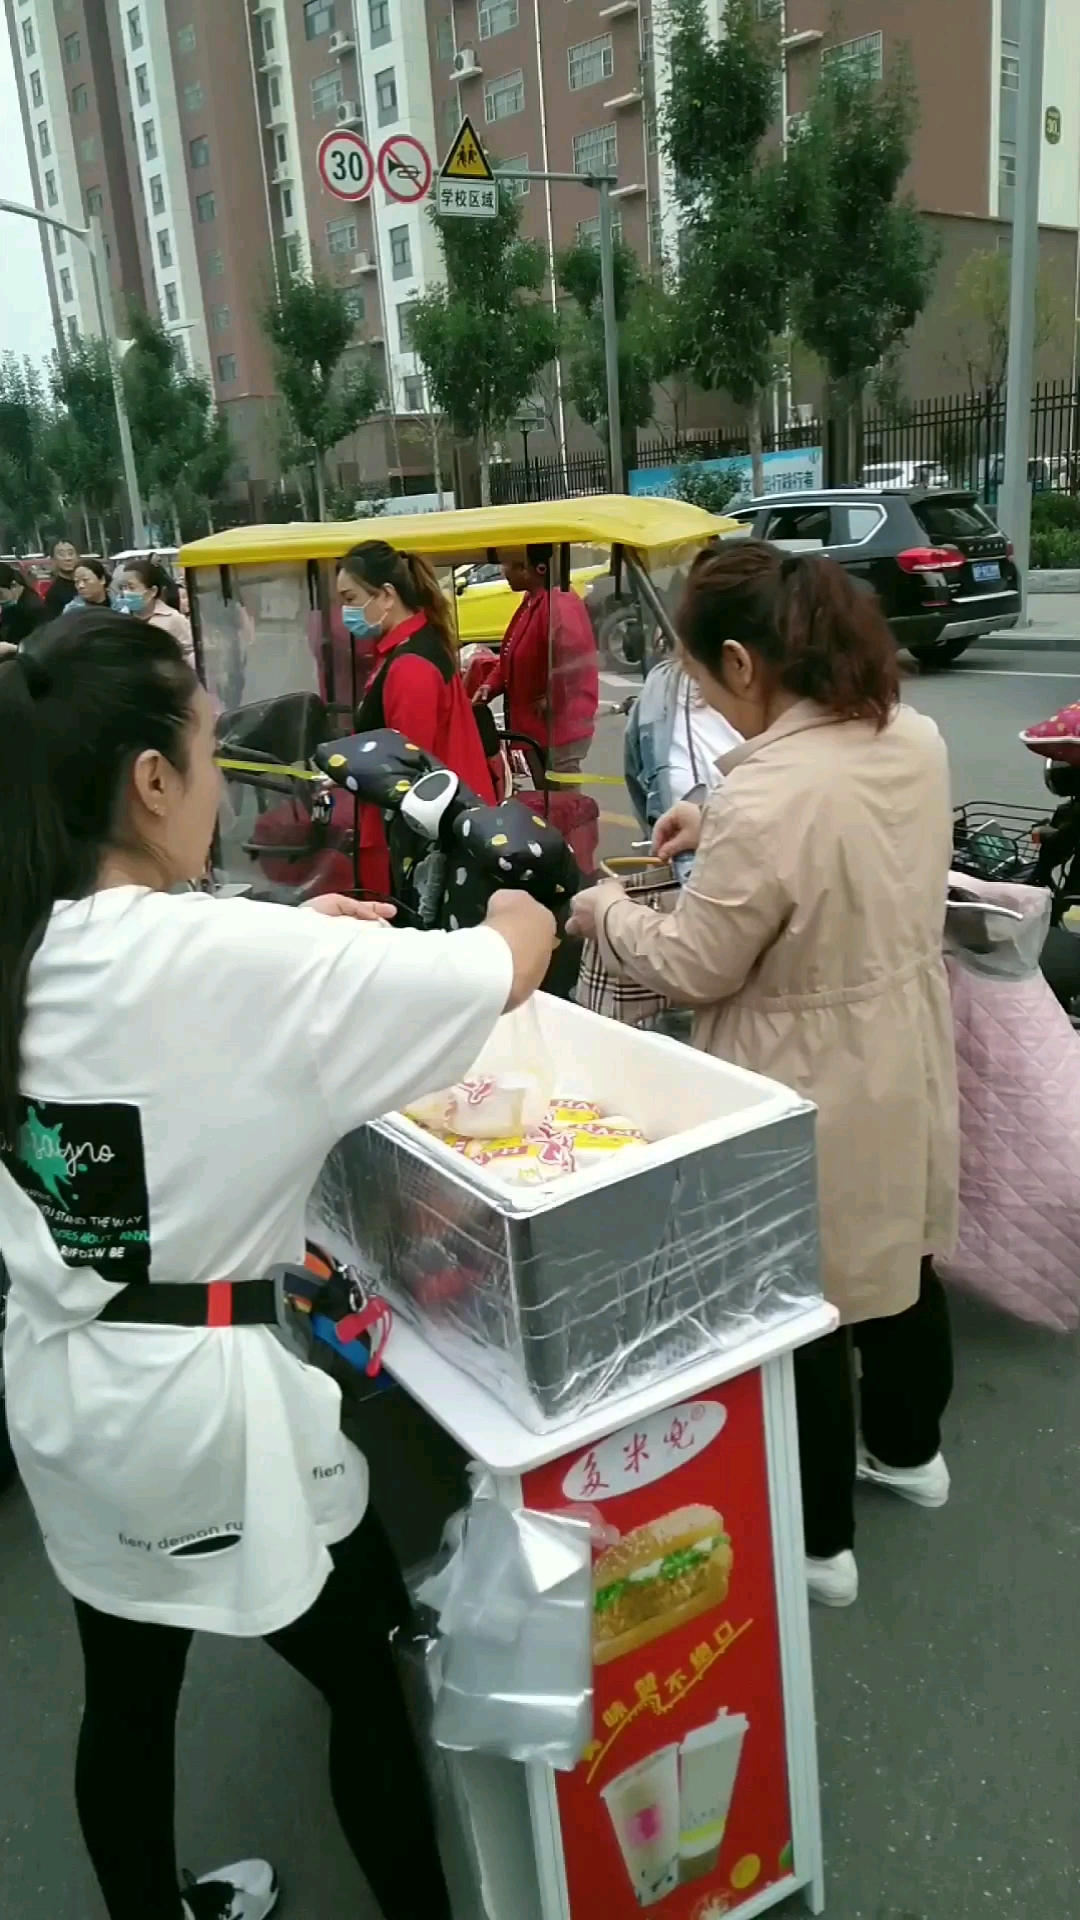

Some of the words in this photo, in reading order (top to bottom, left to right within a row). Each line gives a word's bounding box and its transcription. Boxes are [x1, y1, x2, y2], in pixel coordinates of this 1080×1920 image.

[331, 150, 364, 182] 30
[441, 189, 494, 208] 学校区域
[90, 1216, 110, 1228] THE
[112, 1215, 142, 1228] WAY
[158, 1526, 219, 1549] demon
